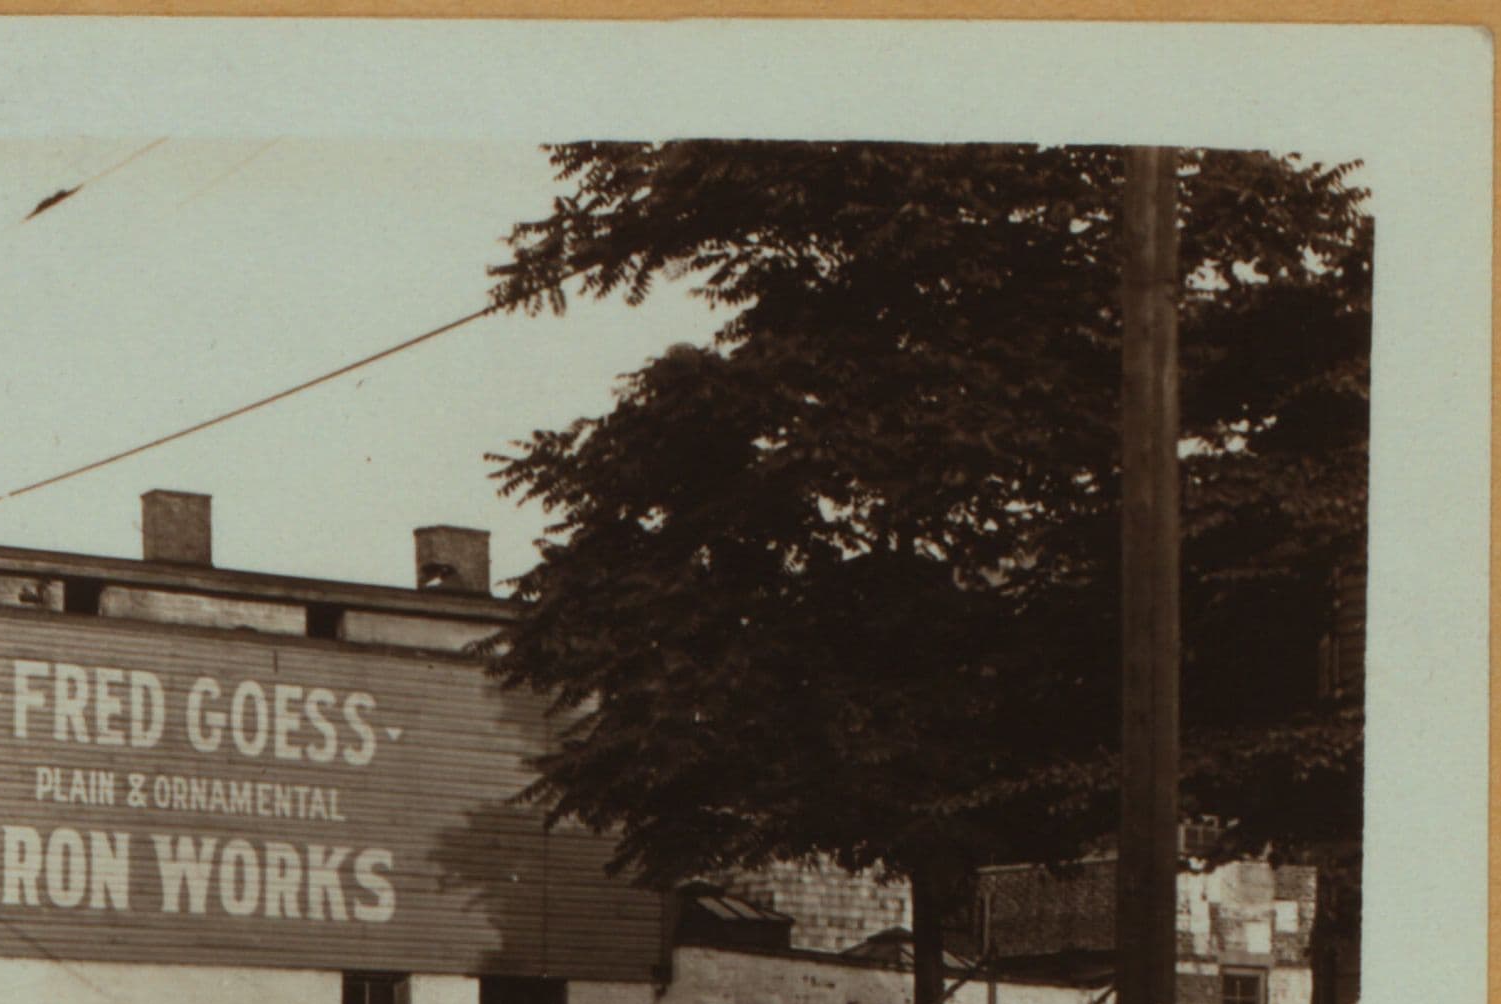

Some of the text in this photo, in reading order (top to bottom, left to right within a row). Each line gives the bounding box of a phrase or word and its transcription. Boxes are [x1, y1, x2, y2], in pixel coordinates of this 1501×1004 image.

[13, 659, 377, 766] FRED GOESS
[35, 767, 346, 822] PLAIN & ORNAMENTAL
[152, 833, 396, 923] WORKS
